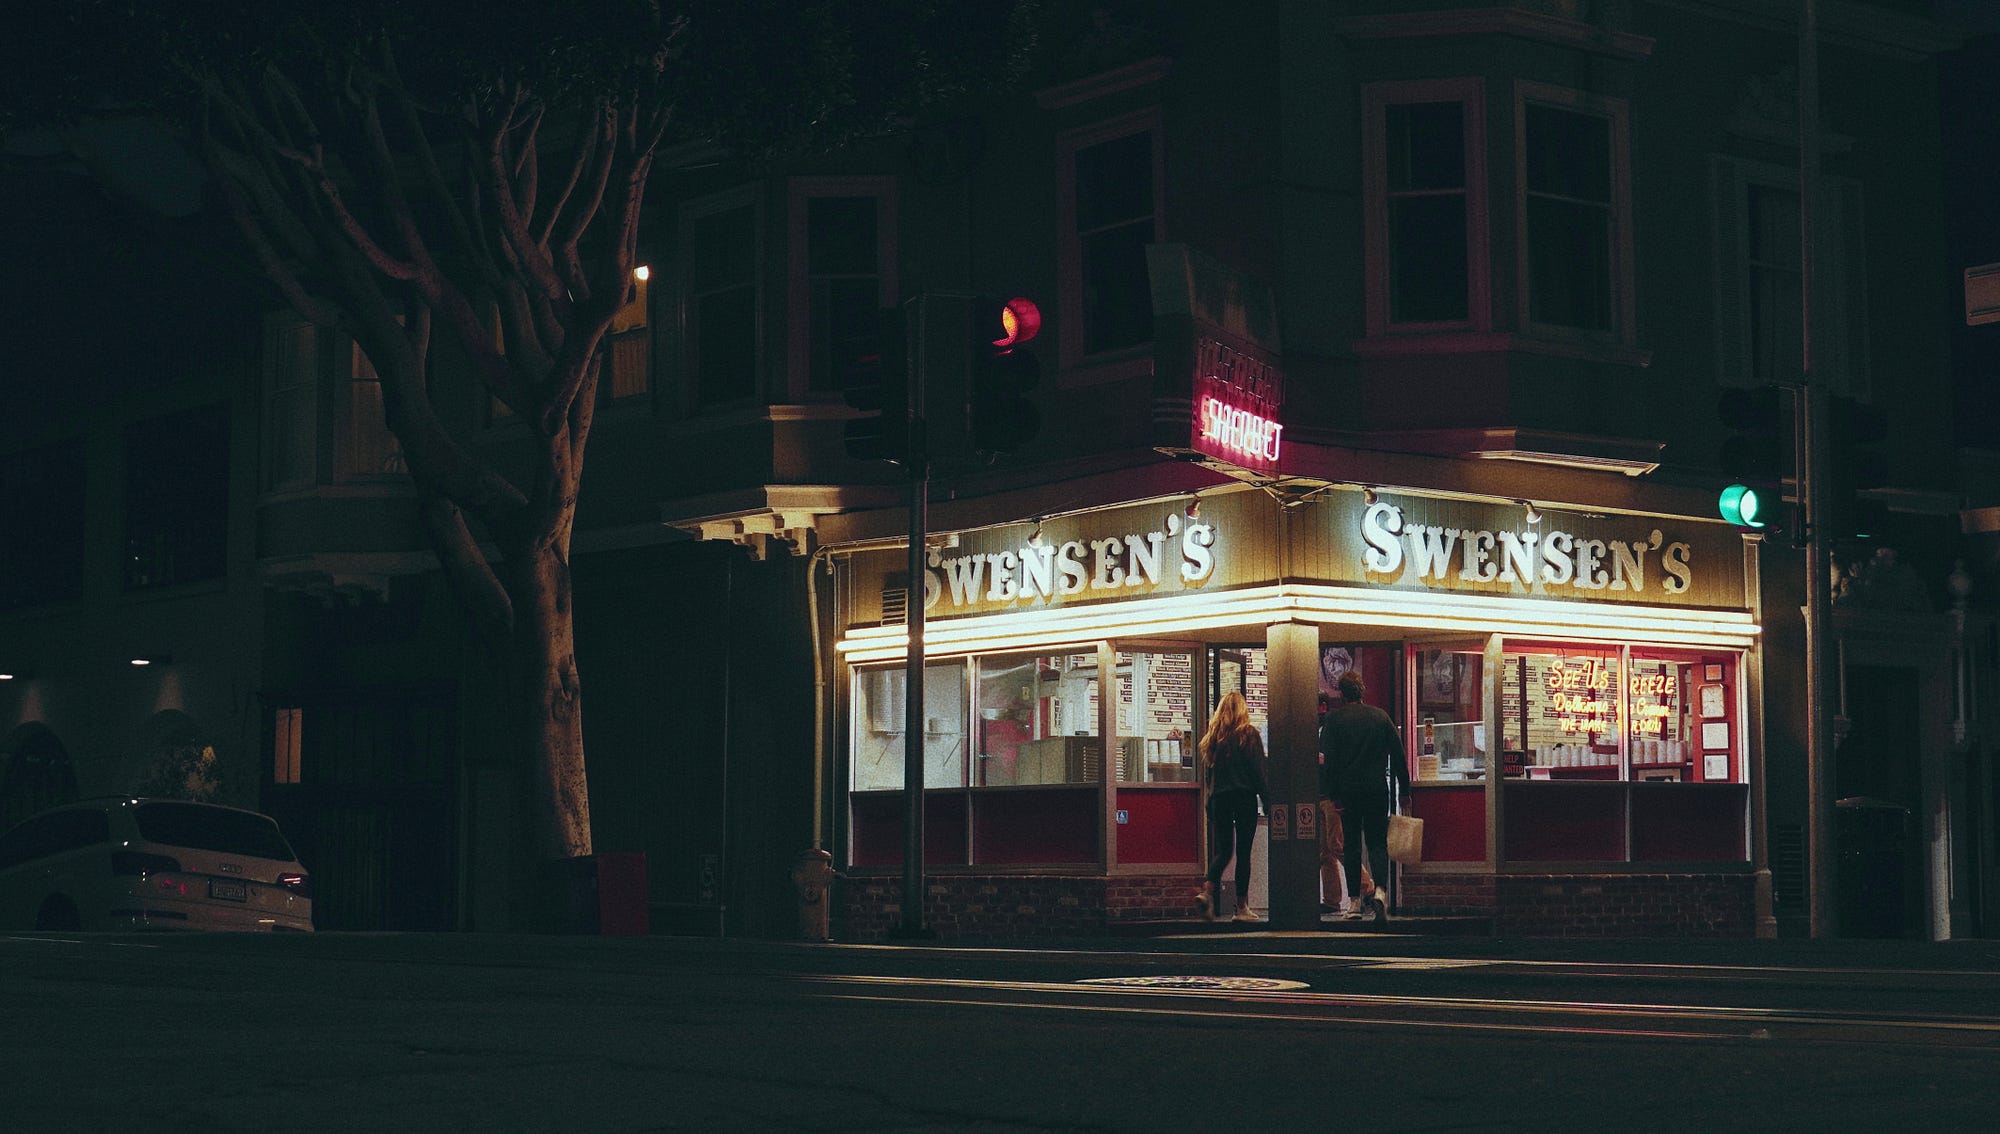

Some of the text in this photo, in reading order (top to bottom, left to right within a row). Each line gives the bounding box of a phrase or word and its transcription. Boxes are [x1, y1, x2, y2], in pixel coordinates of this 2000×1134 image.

[1361, 502, 1692, 594] SWENSEN'S
[1629, 674, 1676, 695] REEZE
[1504, 754, 1519, 763] HELP
